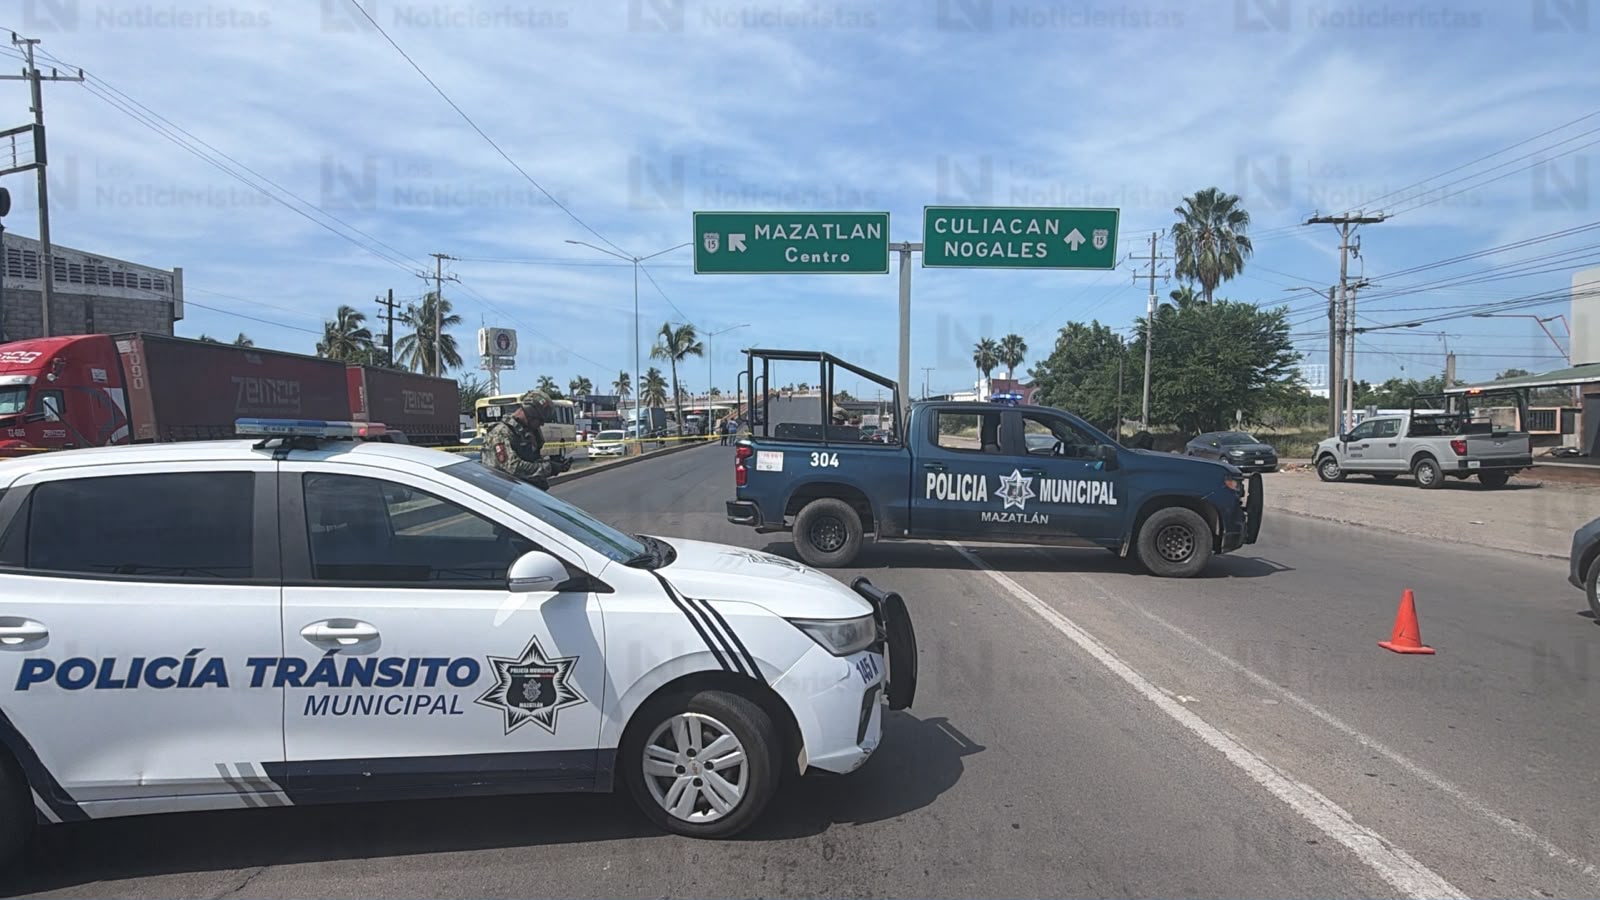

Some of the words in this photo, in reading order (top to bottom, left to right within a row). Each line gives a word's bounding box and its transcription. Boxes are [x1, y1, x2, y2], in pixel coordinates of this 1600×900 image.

[754, 223, 881, 240] MAZATLAN
[934, 217, 1059, 235] CULIACAN
[708, 240, 717, 249] 15
[944, 241, 1048, 258] NOGALES
[785, 247, 850, 263] Centro
[810, 452, 839, 468] 304
[926, 472, 988, 502] POLICIA
[1040, 478, 1117, 505] MUNICIPAL
[981, 511, 1049, 525] MAZATLÁN
[14, 648, 228, 691] POLICÍA
[246, 648, 481, 689] TRÁNSITO
[303, 693, 465, 716] MUNICIPAL
